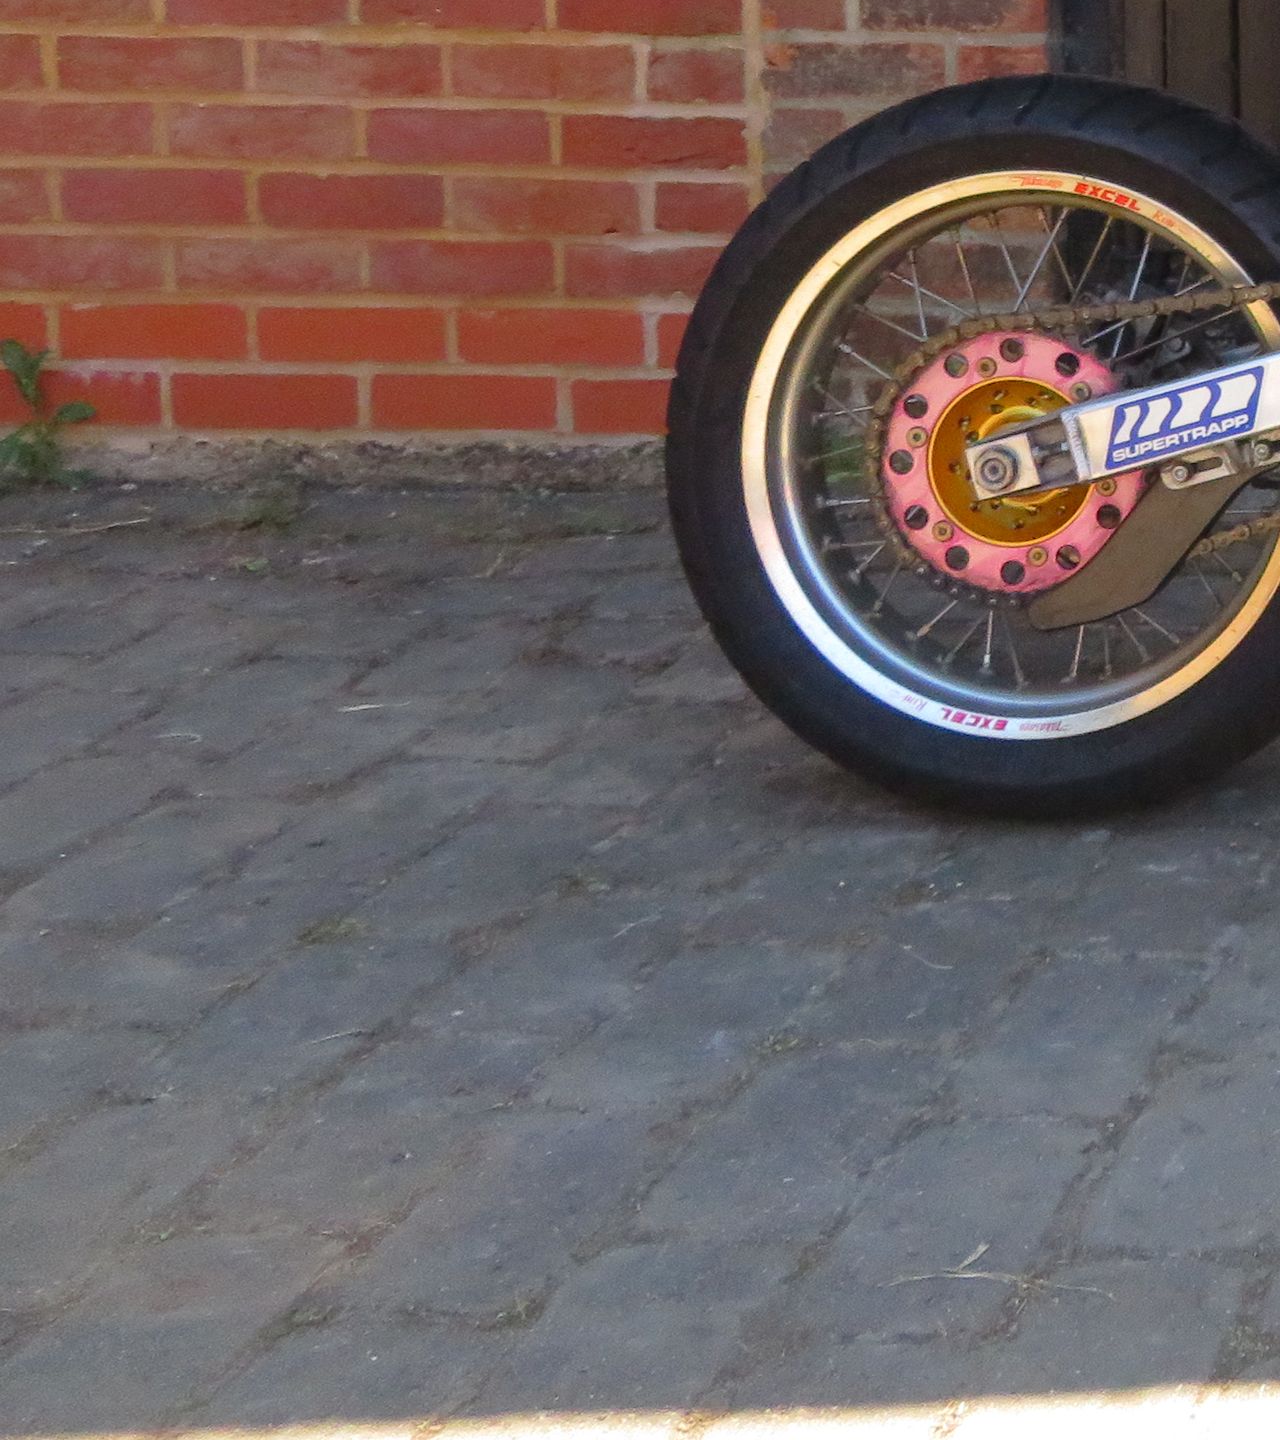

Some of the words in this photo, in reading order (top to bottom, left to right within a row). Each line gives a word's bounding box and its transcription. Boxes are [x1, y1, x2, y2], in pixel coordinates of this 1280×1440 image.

[1073, 181, 1141, 212] EXCEL
[1112, 414, 1249, 463] SUPERTRAPP
[941, 706, 1009, 731] EXCEL
